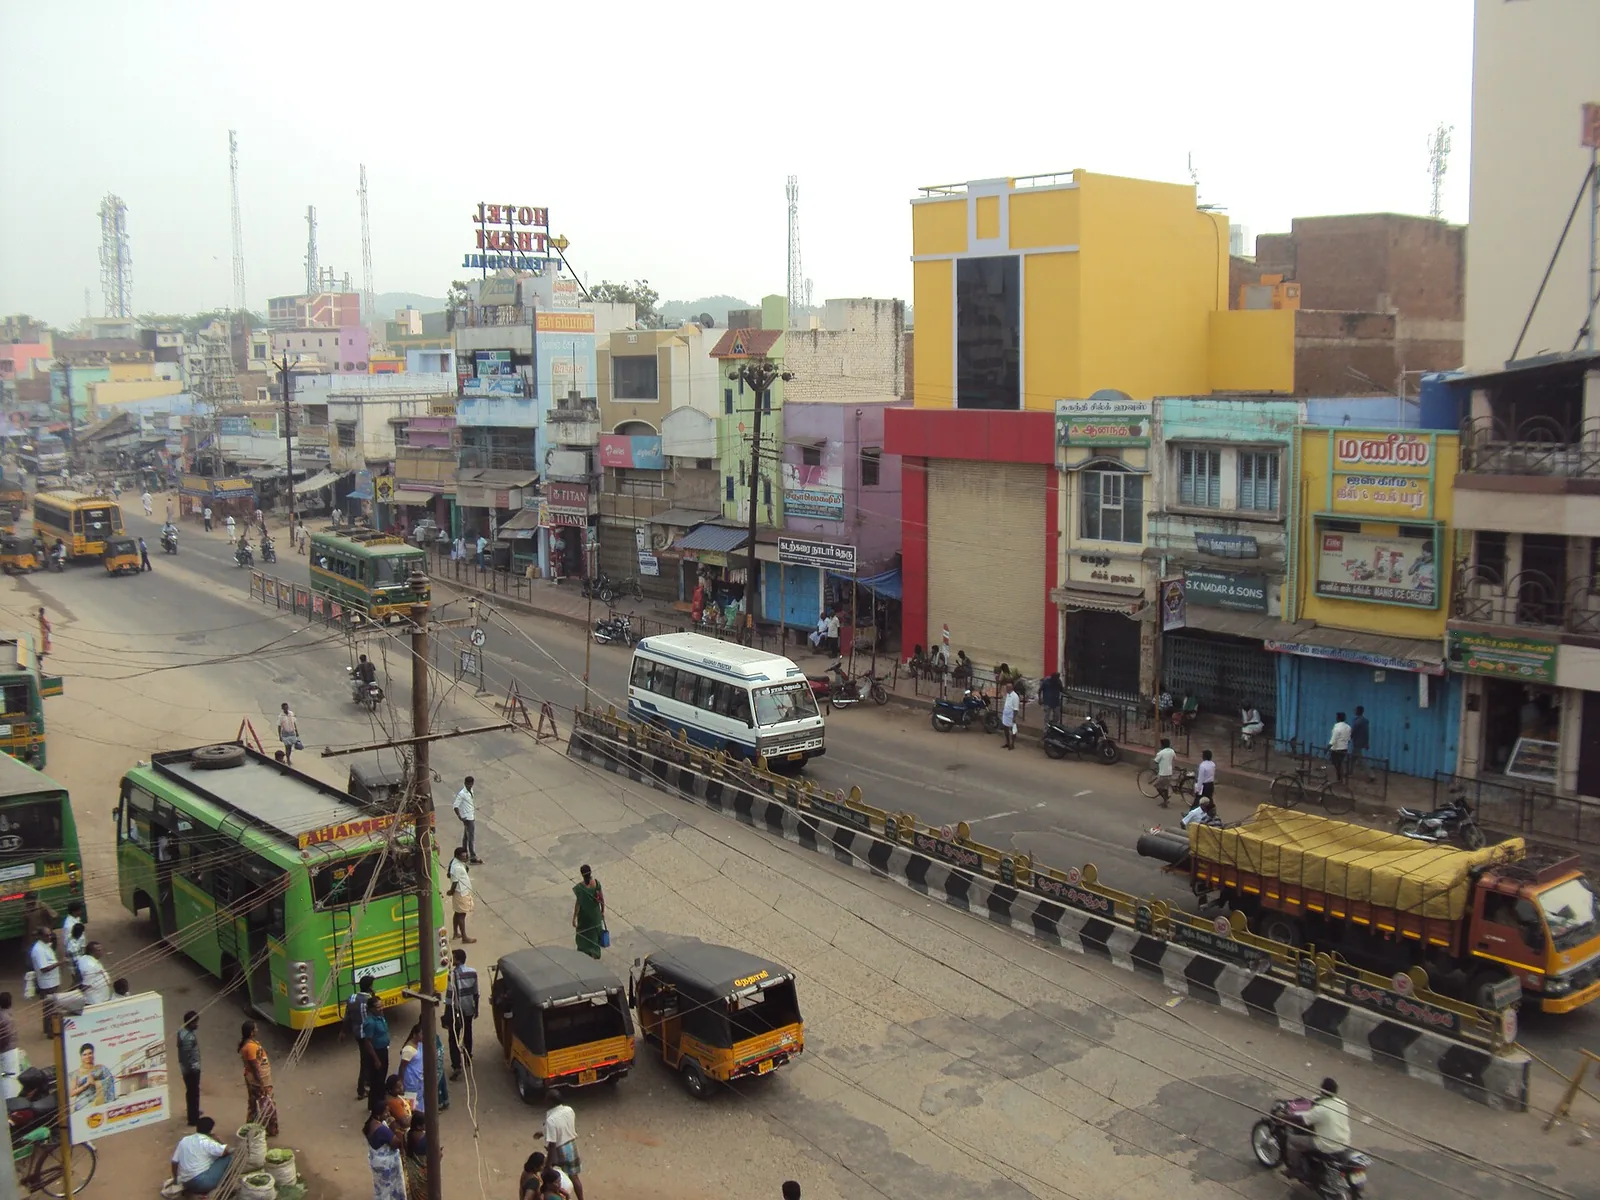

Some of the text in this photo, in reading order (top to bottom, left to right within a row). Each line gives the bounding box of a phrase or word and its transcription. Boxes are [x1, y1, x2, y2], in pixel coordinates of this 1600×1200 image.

[1338, 433, 1428, 464] மணீஸ்
[561, 490, 586, 501] TITAN
[557, 513, 581, 525] TITAN
[780, 541, 853, 560] கடற்கரை நாடார் தெரு
[1236, 586, 1264, 599] SONS
[1395, 589, 1405, 600] ICE
[1406, 590, 1433, 602] CREAMS
